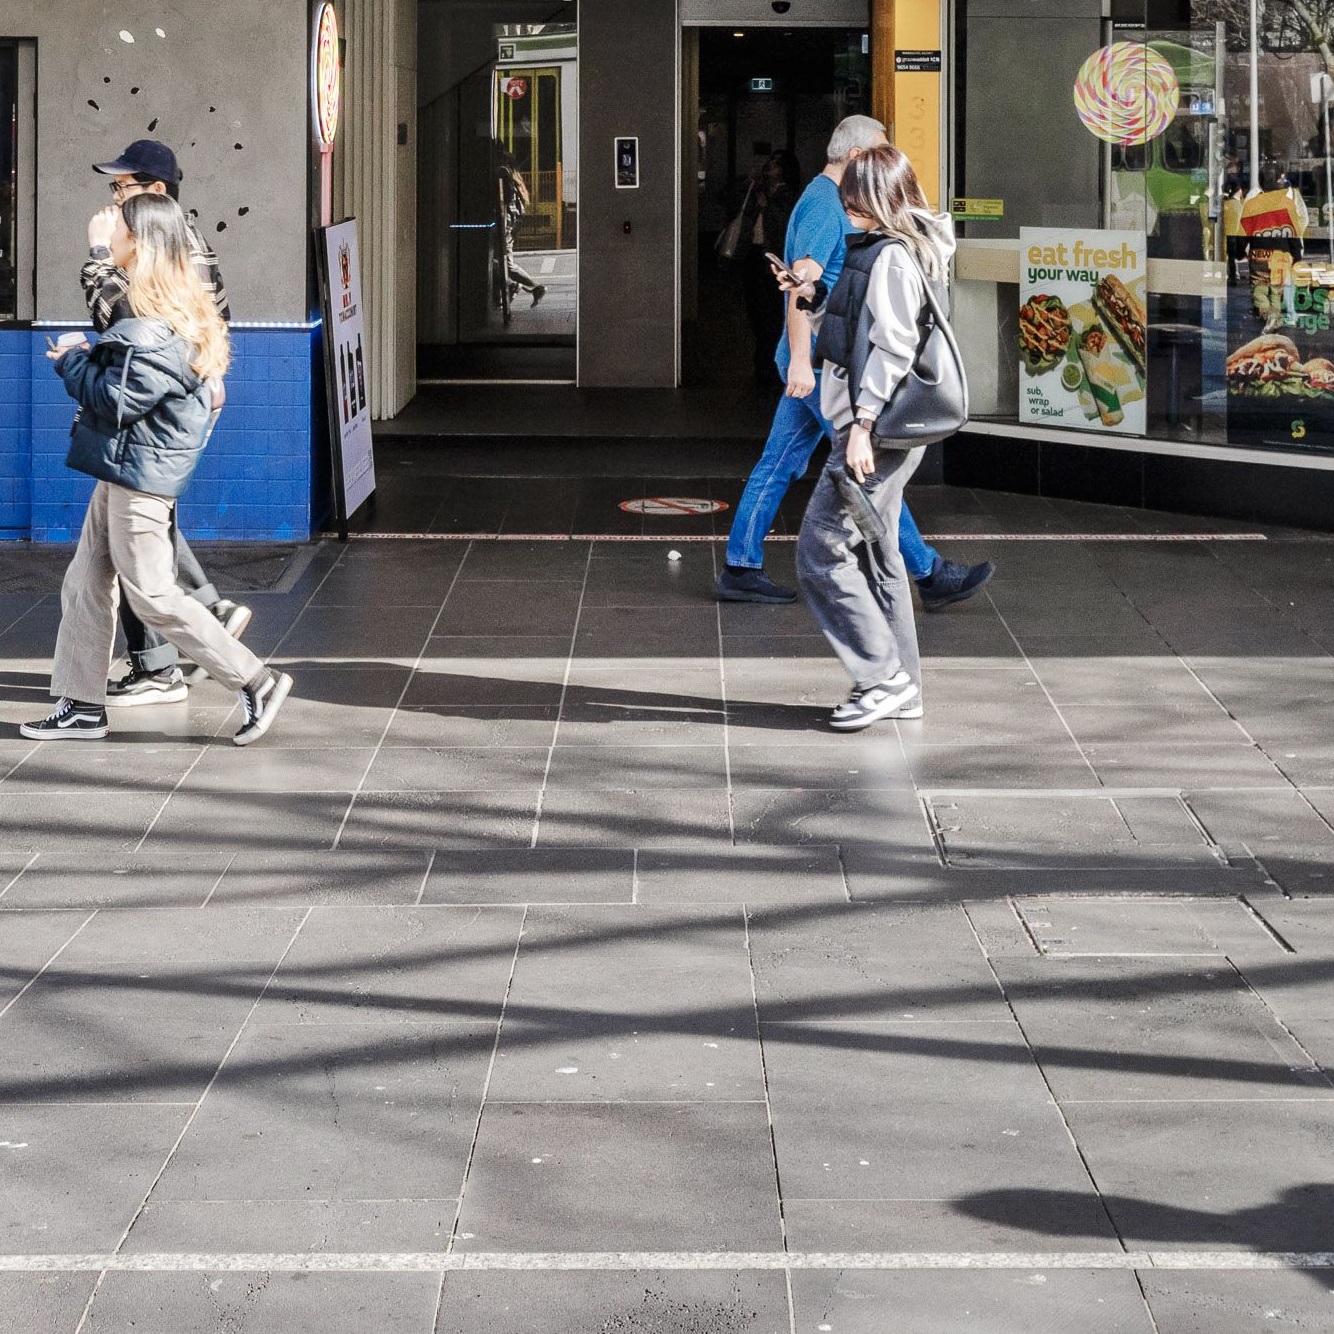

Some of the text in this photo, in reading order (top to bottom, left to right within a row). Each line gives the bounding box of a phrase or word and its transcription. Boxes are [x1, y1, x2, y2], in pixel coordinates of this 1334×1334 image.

[1027, 240, 1137, 270] eat fresh
[1027, 267, 1100, 287] your way
[1026, 385, 1044, 397] sub,
[1028, 395, 1050, 407] wrap
[1030, 406, 1064, 417] or salad
